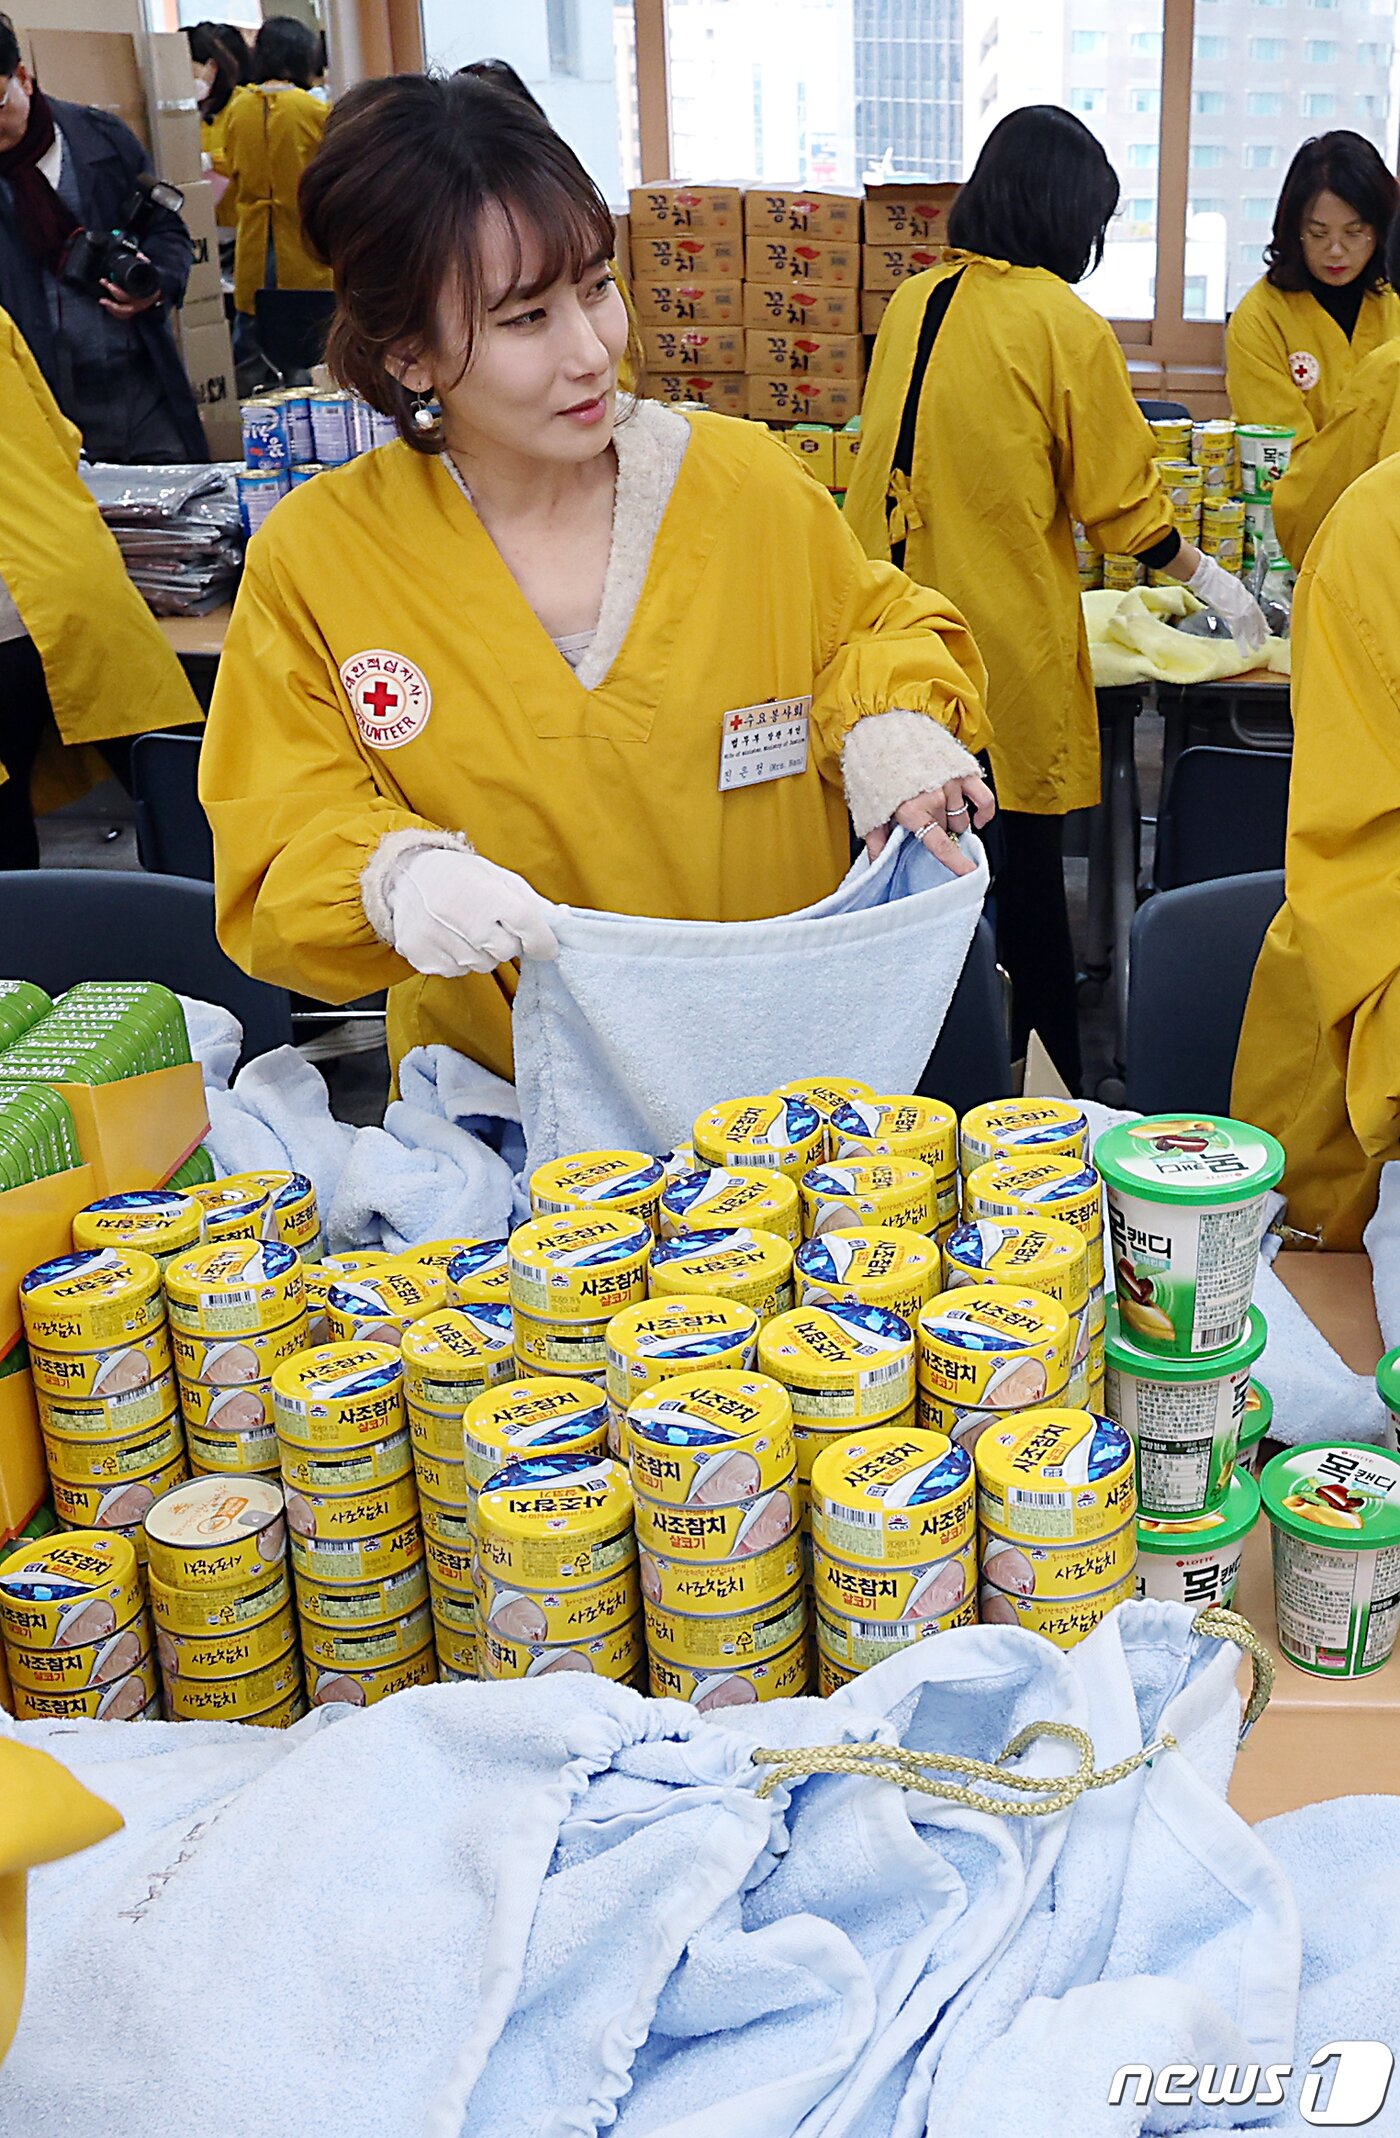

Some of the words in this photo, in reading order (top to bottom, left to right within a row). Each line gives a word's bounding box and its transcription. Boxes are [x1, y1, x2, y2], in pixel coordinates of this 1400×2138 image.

[648, 194, 692, 226] 꽁치
[766, 197, 809, 232] 꽁치
[886, 204, 929, 237] 꽁치
[653, 240, 694, 273] 꽁치
[766, 244, 809, 279] 꽁치
[652, 288, 695, 319] 꽁치
[763, 291, 806, 325] 꽁치
[657, 333, 700, 365] 꽁치
[768, 338, 809, 371] 꽁치
[768, 382, 810, 415] 꽁치
[345, 658, 422, 696] 대한적십자사
[744, 702, 803, 727] 수요봉사회
[731, 733, 760, 749] 법무부
[986, 1109, 1059, 1128] 사조참치
[555, 1160, 629, 1188] 사조참치
[992, 1164, 1061, 1191] 사조참치
[536, 1222, 620, 1250] 사조참치
[579, 1265, 644, 1297] 사조참치
[599, 1289, 632, 1308] 살코기
[32, 1321, 82, 1338] 사조참치
[635, 1314, 728, 1333] 사조참치
[964, 1299, 1044, 1333] 사조참치
[794, 1321, 851, 1362] 사조참치
[34, 1354, 86, 1379] 사조참치
[298, 1351, 378, 1382] 사조참치
[921, 1347, 976, 1384] 사조참치
[338, 1393, 400, 1425] 사조참치
[492, 1391, 580, 1424] 사조참치
[681, 1387, 760, 1424] 사조참치
[358, 1416, 389, 1434] 살코기
[1012, 1424, 1072, 1473] 사조참치
[844, 1442, 924, 1488] 사조참치
[1317, 1452, 1397, 1491] 목캔디
[330, 1501, 389, 1524] 사조참치
[509, 1495, 608, 1514] 사조참치
[653, 1513, 726, 1536] 사조참치
[669, 1535, 706, 1550] 살코기
[43, 1549, 112, 1577] 사조참치
[1055, 1551, 1116, 1580] 사조참치
[1186, 1555, 1215, 1566] LOTTE
[677, 1577, 744, 1598] 사조참치
[828, 1567, 897, 1598] 사조참치
[567, 1590, 627, 1624] 사조참치
[842, 1593, 877, 1611] 살코기
[1039, 1611, 1104, 1635] 사조참치
[18, 1654, 83, 1672] 사조참치
[192, 1646, 249, 1665] 사조참치
[24, 1697, 88, 1716] 사조참치
[182, 1691, 236, 1709] 사조참치
